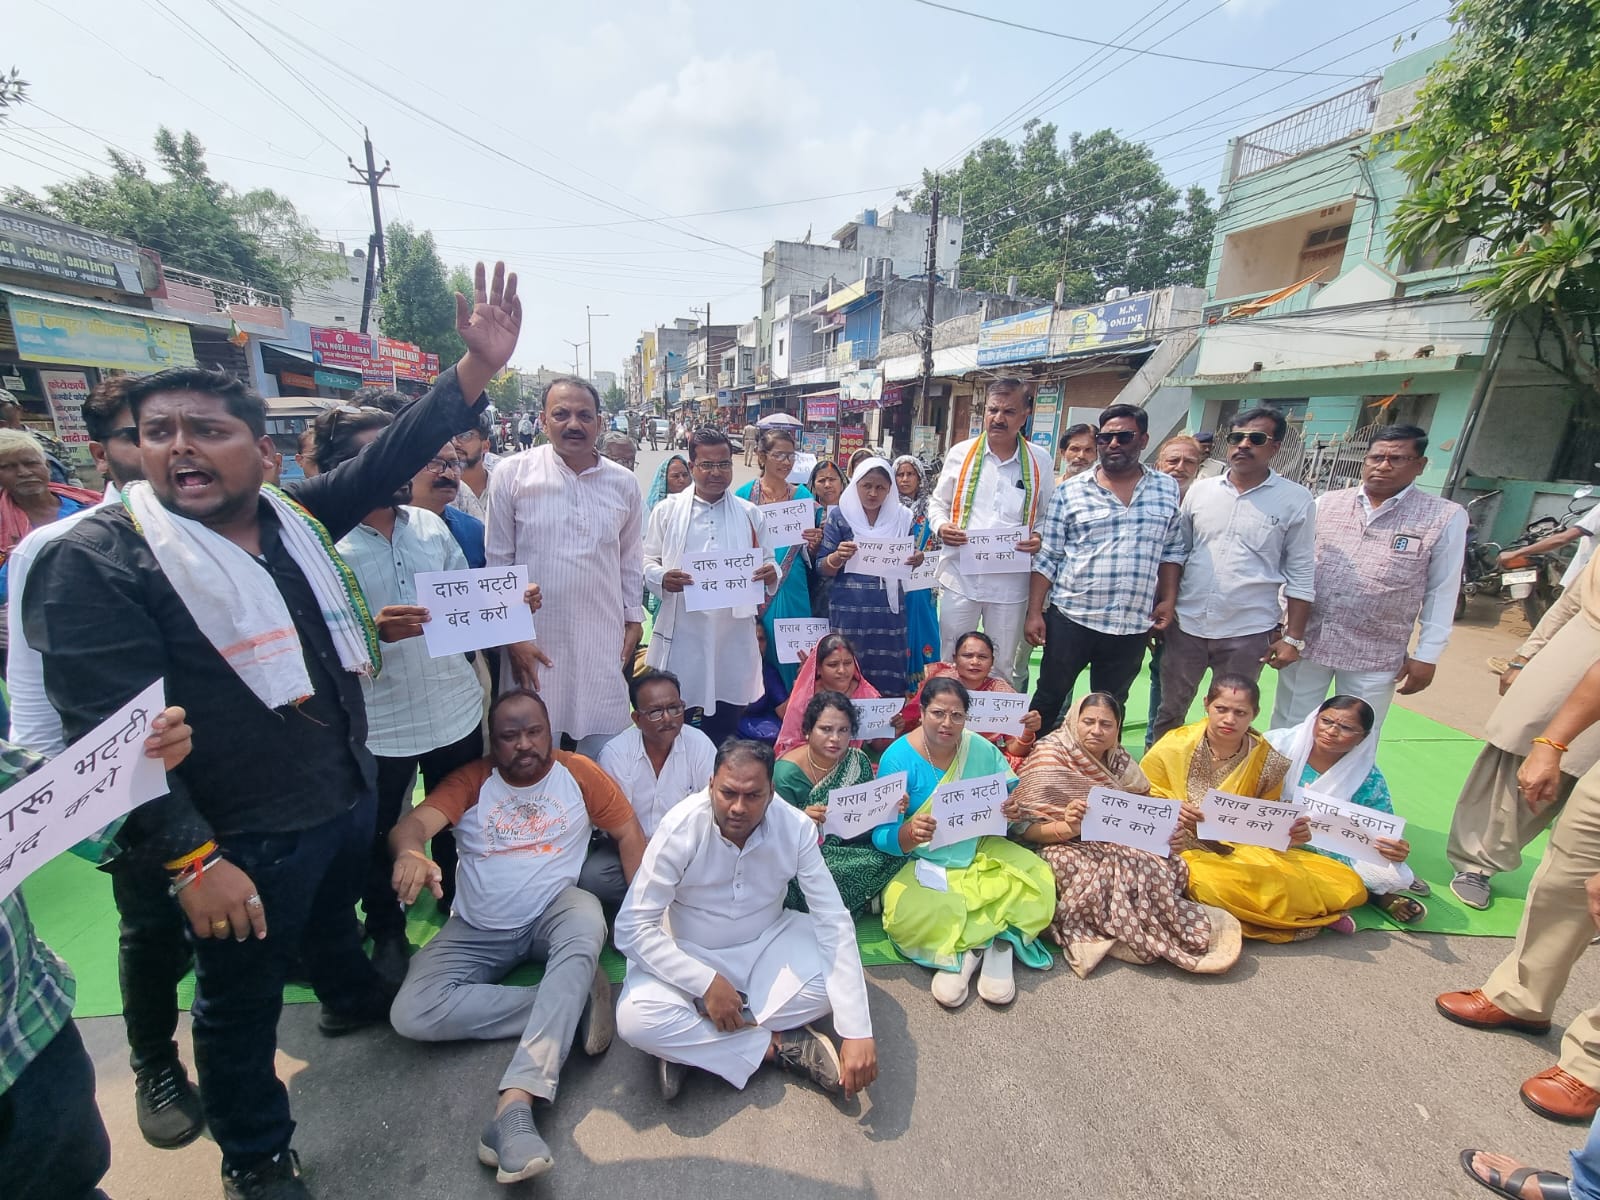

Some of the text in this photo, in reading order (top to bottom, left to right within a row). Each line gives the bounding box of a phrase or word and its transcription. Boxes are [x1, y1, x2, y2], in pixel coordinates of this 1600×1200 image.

[0, 240, 16, 254] CA
[25, 246, 60, 264] PGDCA
[66, 255, 89, 271] DATA
[89, 261, 115, 276] ENTRY
[1109, 303, 1144, 328] M.N. ONLINE
[783, 503, 807, 517] भट्टी
[784, 521, 801, 533] करो
[858, 541, 884, 551] शराब
[969, 535, 990, 545] दारू
[692, 553, 754, 572] दारू भट्टी
[862, 555, 901, 567] बंद करो
[974, 548, 1015, 561] बंद करो
[432, 571, 518, 598] दारू भट्टी
[701, 576, 747, 592] बंद करो
[445, 601, 508, 627] बंद करो
[779, 623, 827, 635] शराब दुकान
[786, 639, 800, 649] बंद
[870, 702, 896, 714] भट्टी
[992, 698, 1025, 711] दुकान
[867, 720, 885, 729] करो
[987, 715, 1009, 723] करो
[74, 708, 148, 775] भट्टी
[64, 765, 122, 818] करो
[836, 779, 903, 807] शराब दुकान
[940, 779, 1001, 805] दारू भट्टी
[843, 802, 888, 824] बंद करो
[947, 806, 992, 828] बंद करो
[1100, 793, 1173, 820] दारू भट्टी
[1212, 795, 1300, 820] शराब दुकान
[1302, 796, 1397, 836] शराब दुकान
[1101, 814, 1157, 836] बंद करो
[1217, 811, 1275, 833] बंद करो
[1309, 818, 1371, 846] बंद करो
